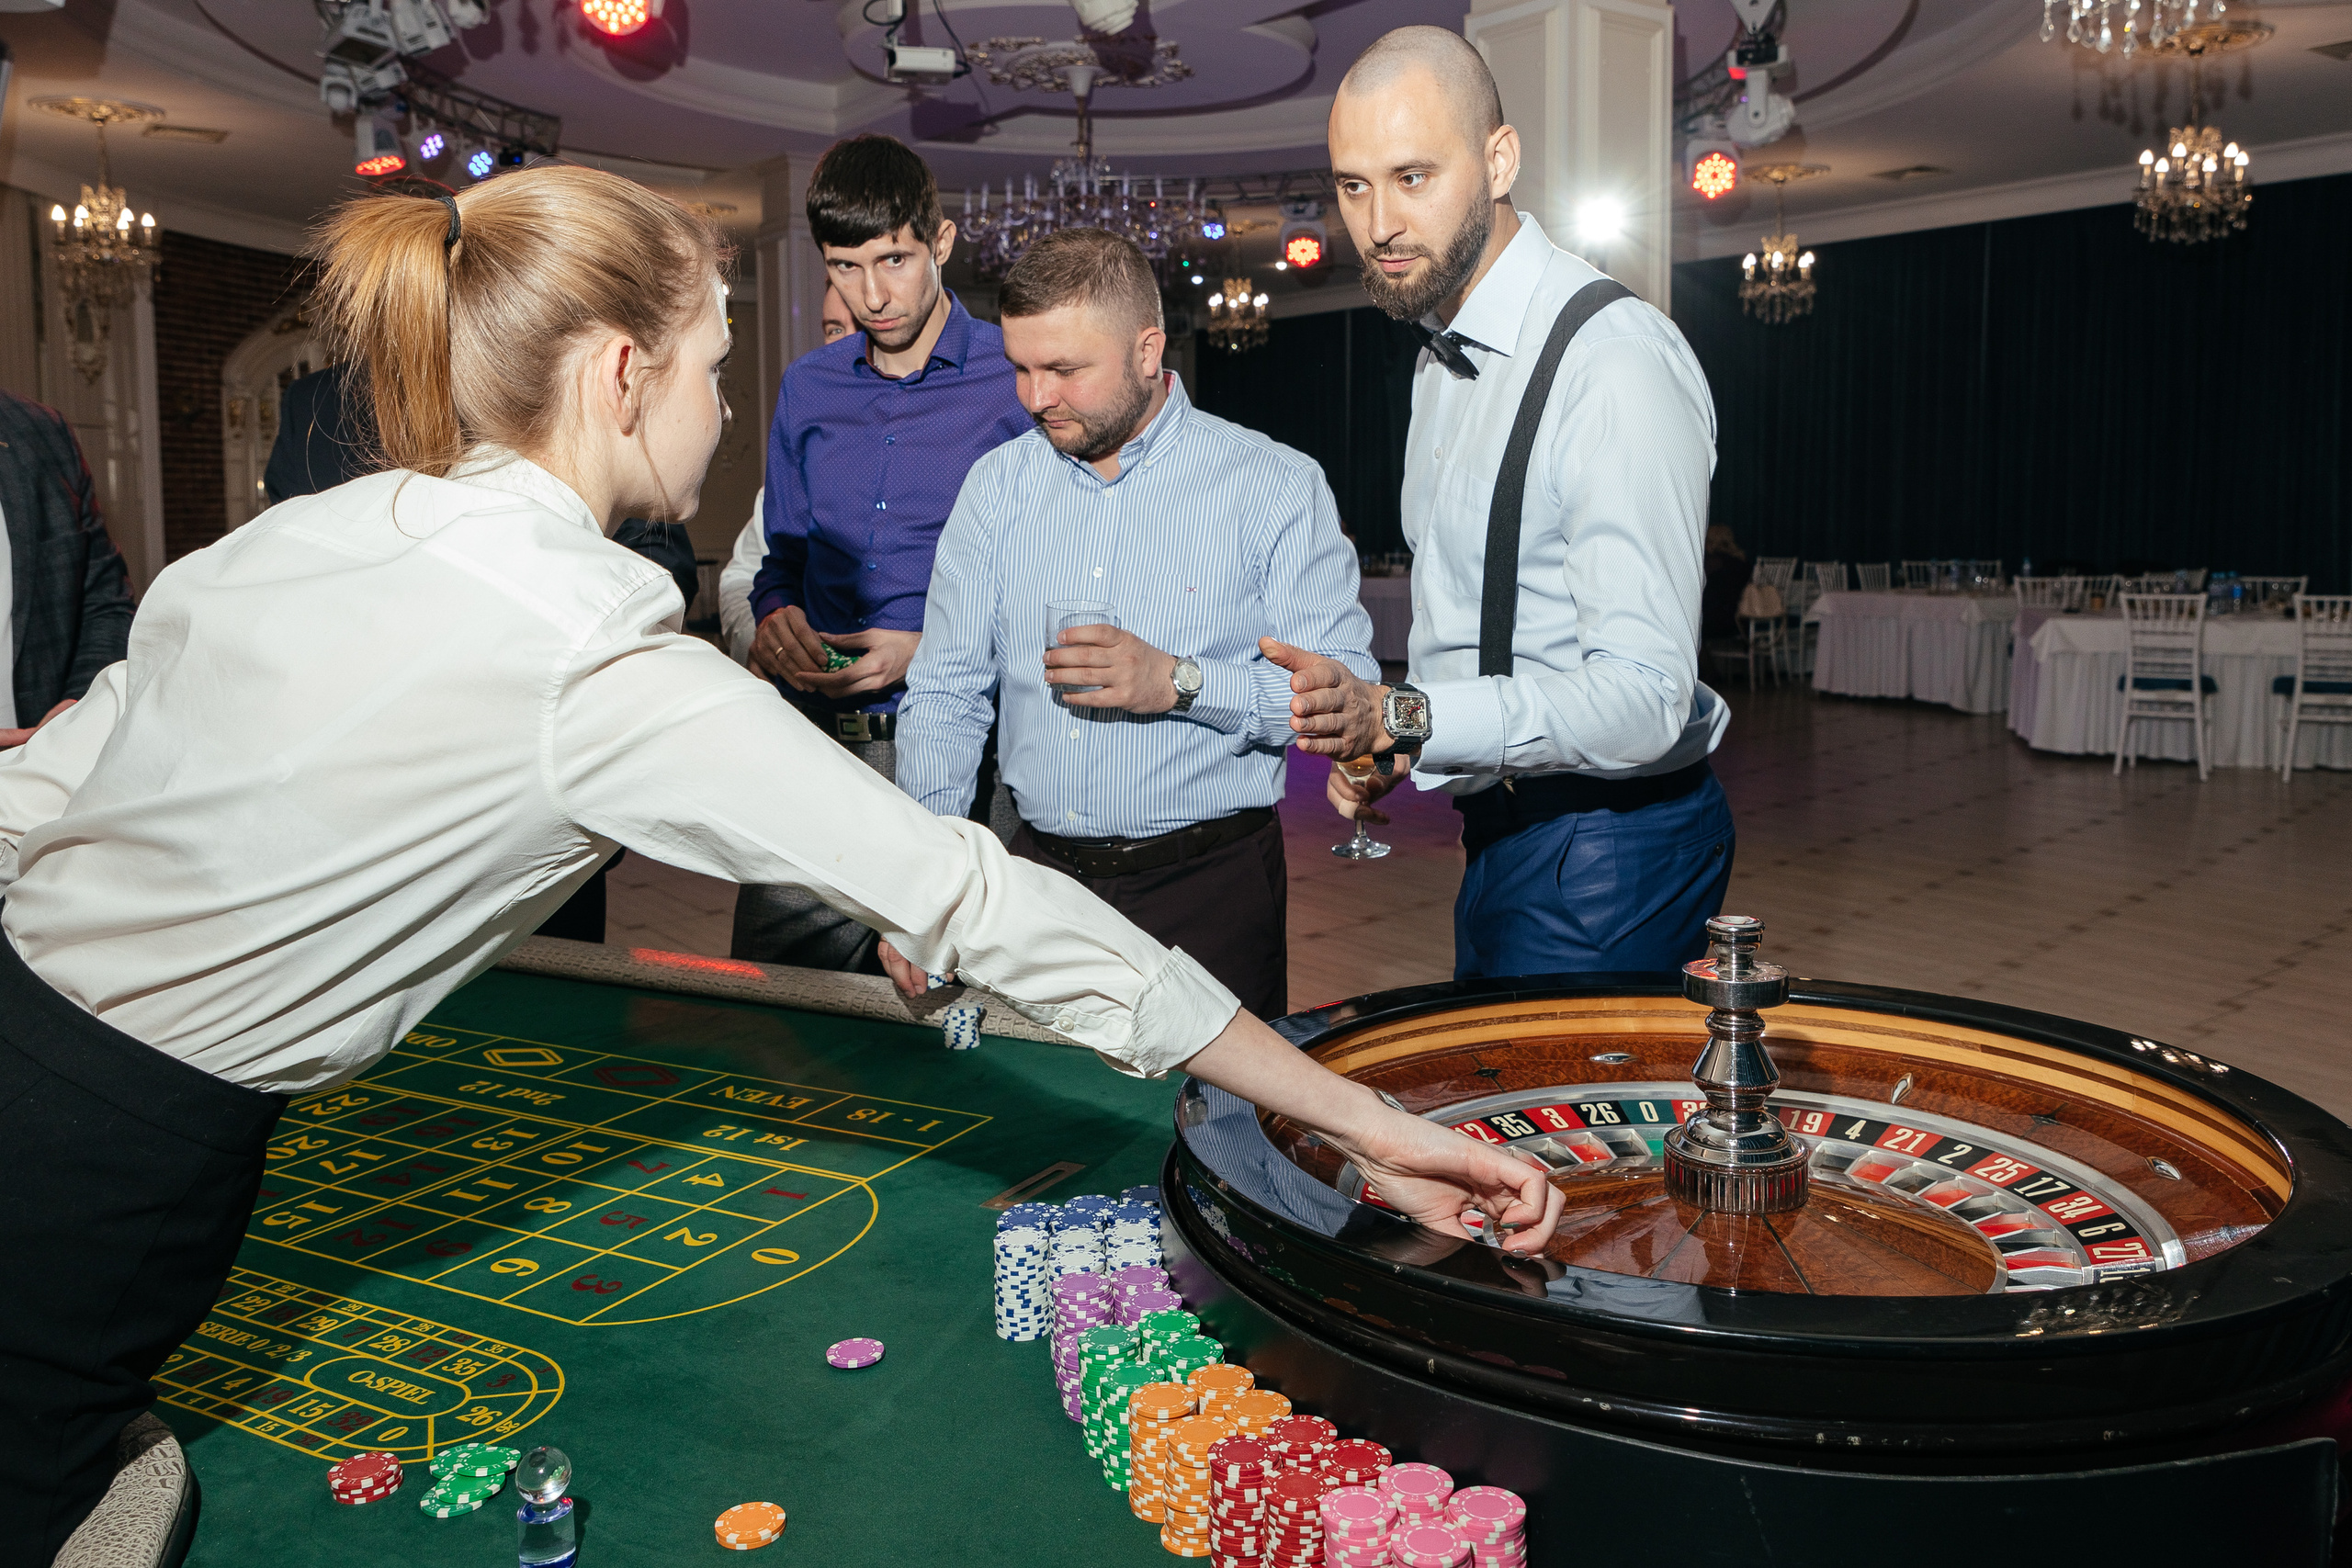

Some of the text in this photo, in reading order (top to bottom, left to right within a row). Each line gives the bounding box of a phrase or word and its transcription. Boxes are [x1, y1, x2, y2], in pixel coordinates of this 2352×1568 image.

[458, 1080, 567, 1106] 2nd 12
[707, 1084, 815, 1110] EVEN
[299, 1093, 369, 1116] 22
[359, 1104, 422, 1126] 19
[1580, 1100, 1621, 1125] 26
[1638, 1100, 1659, 1122] 0
[845, 1108, 898, 1123] 18
[1490, 1112, 1535, 1137] 35
[1541, 1107, 1570, 1129] 3
[1788, 1110, 1825, 1134] 19
[414, 1115, 482, 1138] 16
[1844, 1119, 1868, 1141] 4
[471, 1127, 540, 1151] 13
[702, 1123, 810, 1152] 1st 12
[1883, 1127, 1928, 1154] 21
[319, 1149, 387, 1175] 17
[540, 1140, 611, 1166] 10
[1937, 1144, 1973, 1165] 2
[628, 1159, 673, 1175] 7
[1973, 1156, 2030, 1184] 25
[441, 1176, 519, 1202] 11
[682, 1171, 726, 1189] 4
[2013, 1176, 2072, 1199] 17
[761, 1186, 810, 1201] 1
[263, 1200, 344, 1229] 15
[524, 1196, 572, 1214] 8
[2048, 1196, 2104, 1220] 34
[599, 1210, 650, 1230] 5
[2077, 1222, 2127, 1238] 6
[334, 1215, 419, 1247] 12
[663, 1226, 718, 1247] 2
[751, 1247, 800, 1265] 0
[2092, 1242, 2148, 1259] 27
[275, 1284, 297, 1294] 22
[571, 1273, 624, 1295] 3
[230, 1295, 272, 1312] 22
[340, 1303, 363, 1313] 29
[296, 1315, 339, 1332] 29
[343, 1325, 373, 1339] 7
[412, 1322, 435, 1332] 28
[196, 1321, 313, 1362] SERIE 0/2/3
[368, 1335, 412, 1352] 28
[484, 1343, 508, 1354] 35
[406, 1345, 449, 1363] 12
[441, 1358, 487, 1376] 35
[221, 1377, 254, 1392] 4
[486, 1373, 516, 1388] 3
[250, 1386, 295, 1404] 19
[288, 1398, 336, 1418] 15
[456, 1406, 503, 1426] 26
[254, 1420, 282, 1433] 15
[327, 1411, 375, 1432] 32
[378, 1426, 409, 1442] 0
